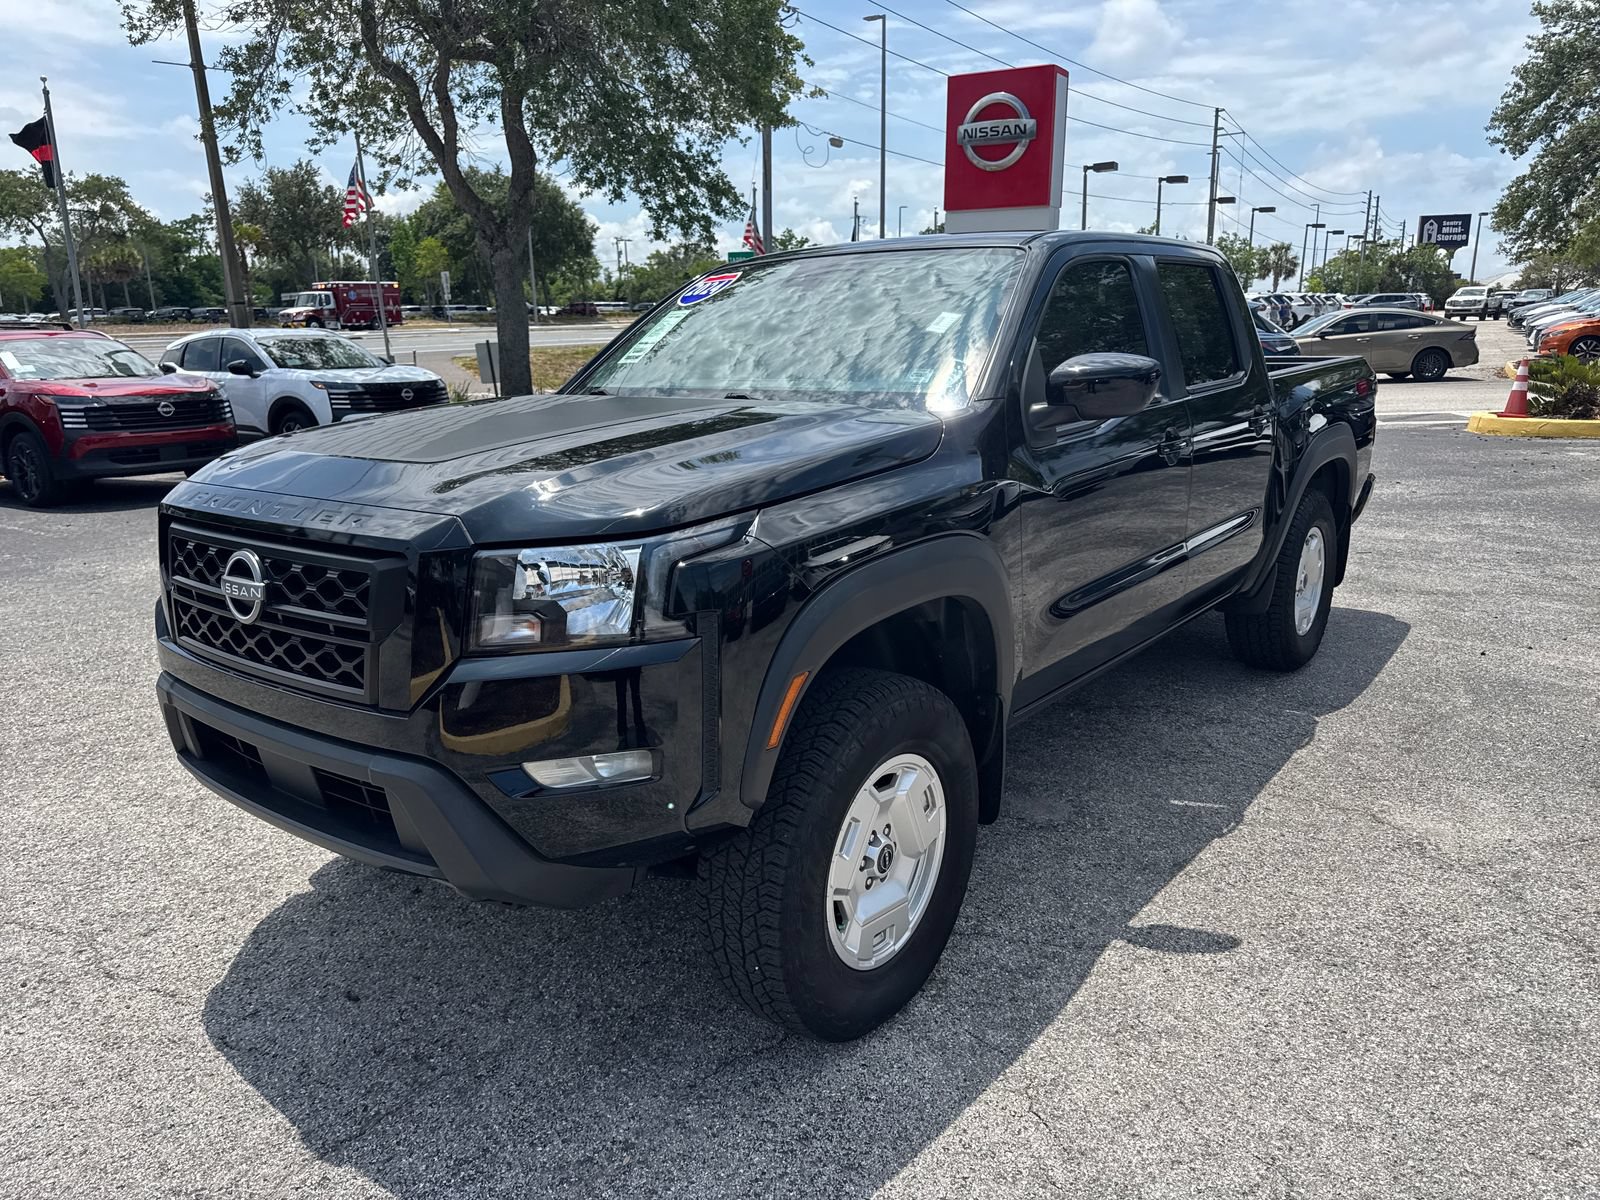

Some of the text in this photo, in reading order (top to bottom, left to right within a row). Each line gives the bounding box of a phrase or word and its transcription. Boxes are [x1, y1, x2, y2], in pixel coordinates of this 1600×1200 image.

[963, 123, 1027, 140] NISSAN
[1436, 233, 1467, 242] Storage
[1441, 226, 1465, 234] Mini-
[186, 490, 374, 529] FRONTIER
[225, 582, 262, 598] SSAN
